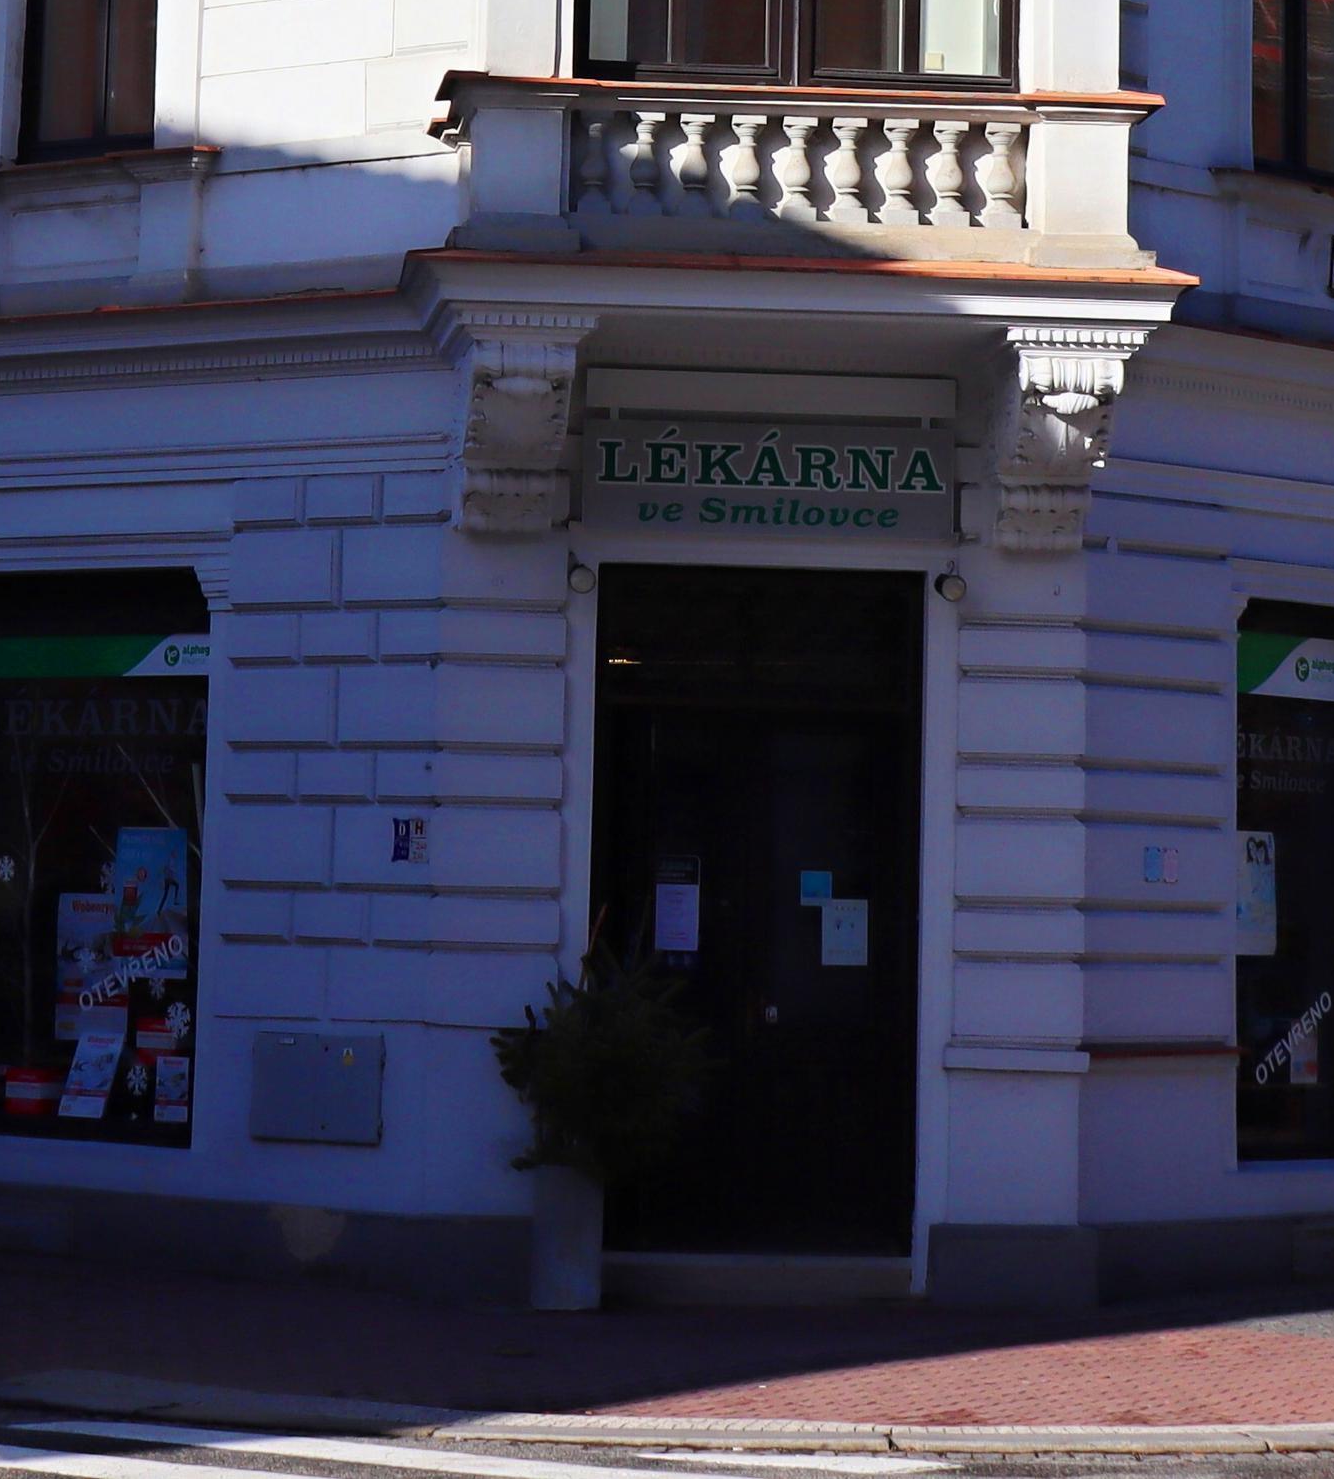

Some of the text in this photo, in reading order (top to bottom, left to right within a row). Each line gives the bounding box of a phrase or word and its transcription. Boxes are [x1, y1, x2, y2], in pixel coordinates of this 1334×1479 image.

[596, 425, 947, 494] LÉKÁRNA
[637, 496, 900, 529] ve Smilovce
